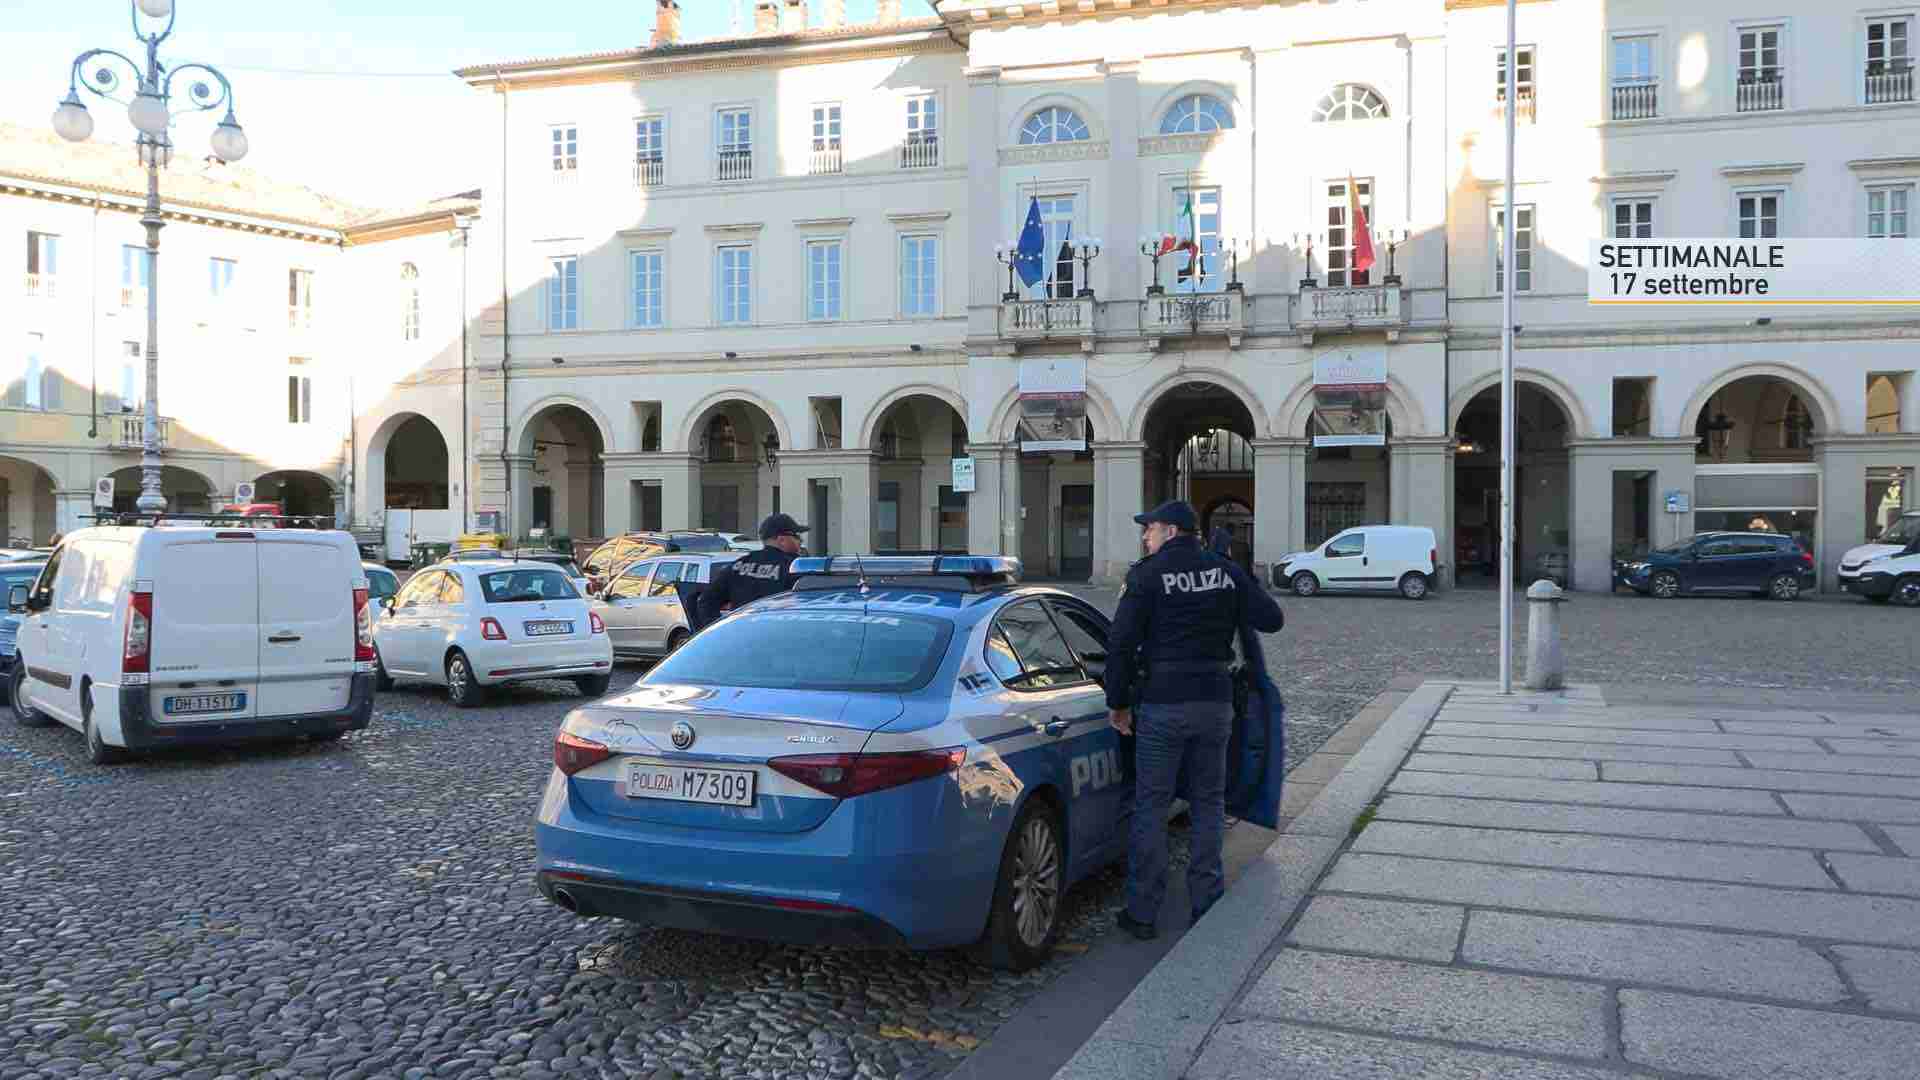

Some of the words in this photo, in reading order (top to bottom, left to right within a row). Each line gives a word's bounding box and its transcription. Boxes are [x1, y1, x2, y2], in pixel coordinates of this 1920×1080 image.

[733, 560, 780, 580] POLIZIA
[1161, 567, 1236, 595] POLIZIA
[631, 771, 674, 793] POLIZIA
[681, 771, 748, 801] M7309
